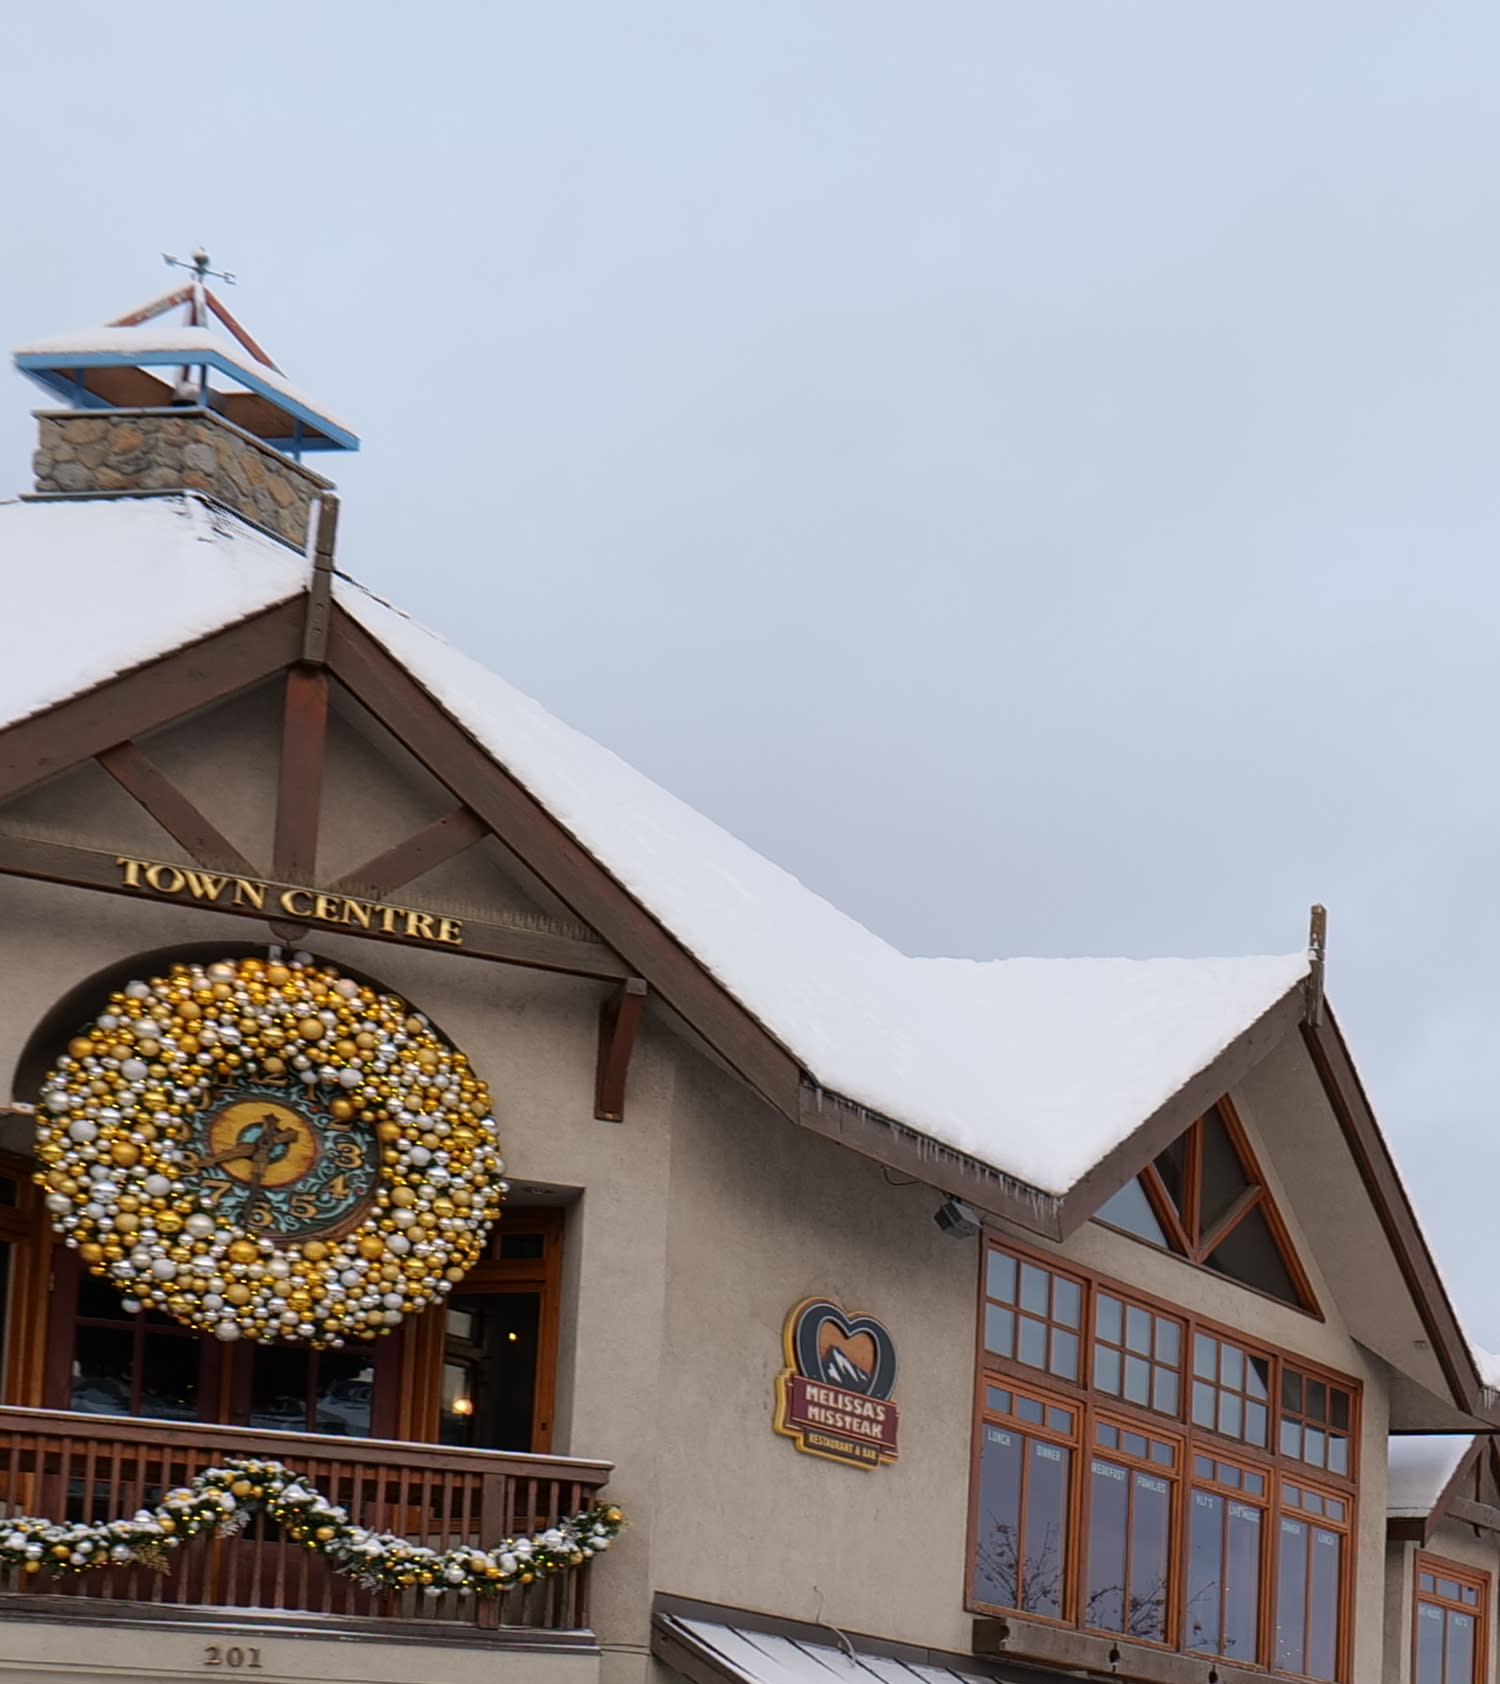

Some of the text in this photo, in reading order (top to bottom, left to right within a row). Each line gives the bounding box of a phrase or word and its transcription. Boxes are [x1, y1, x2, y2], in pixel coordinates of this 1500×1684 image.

[116, 857, 464, 945] TOWN CENTRE
[335, 1143, 363, 1168] 3
[328, 1175, 349, 1199] 4
[290, 1195, 316, 1219] 5
[805, 1384, 886, 1421] MELISSA'S
[807, 1405, 882, 1438] MISSTEAK
[808, 1433, 853, 1454] RESTAURANT
[862, 1447, 876, 1459] BAR
[988, 1428, 1011, 1447] LUNCH
[203, 1645, 264, 1668] 201
